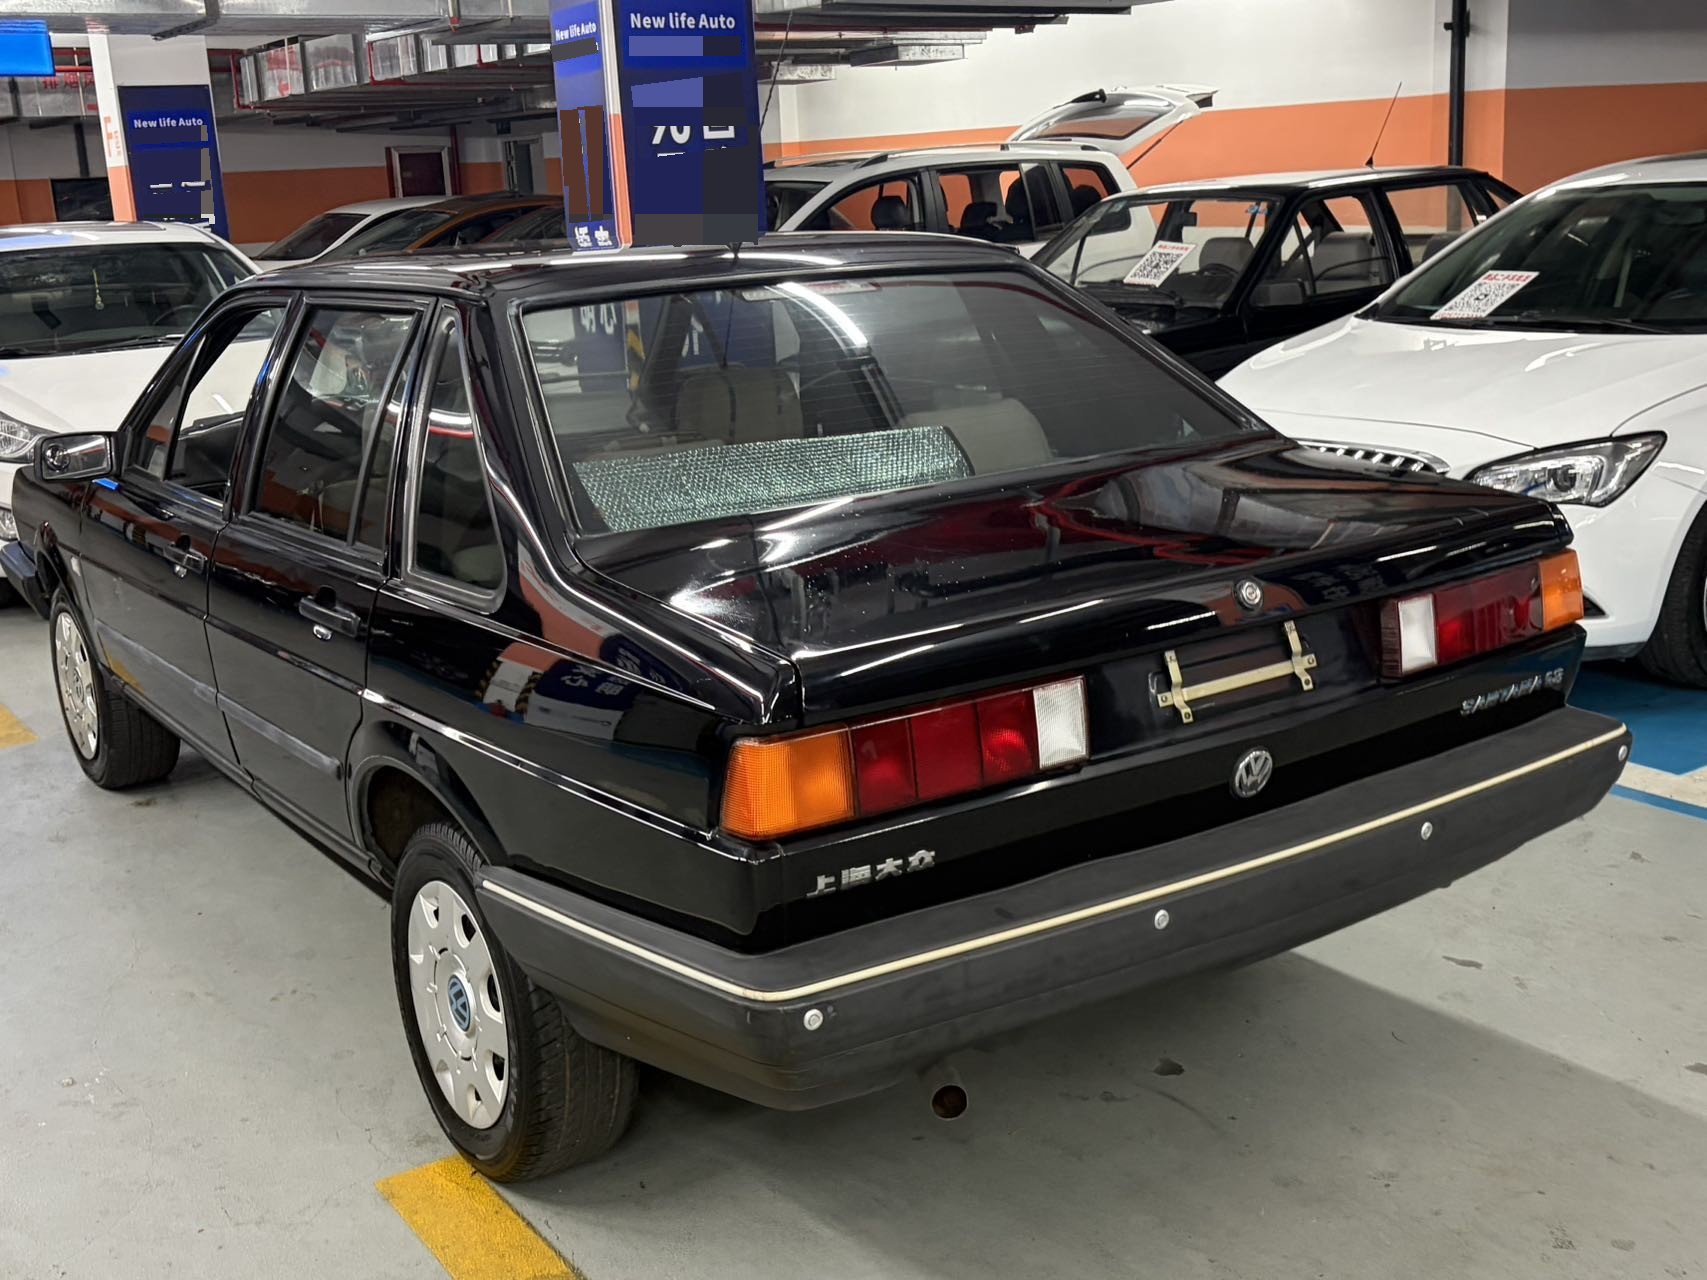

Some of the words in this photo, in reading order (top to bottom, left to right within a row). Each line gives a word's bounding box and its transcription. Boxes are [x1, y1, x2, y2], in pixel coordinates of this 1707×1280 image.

[630, 12, 666, 30] New
[668, 12, 697, 30] life
[698, 13, 737, 30] Auto
[555, 29, 569, 41] New
[569, 23, 581, 38] life
[581, 21, 597, 36] Auto
[133, 118, 158, 129] New
[158, 117, 178, 128] life
[178, 116, 204, 128] Auto
